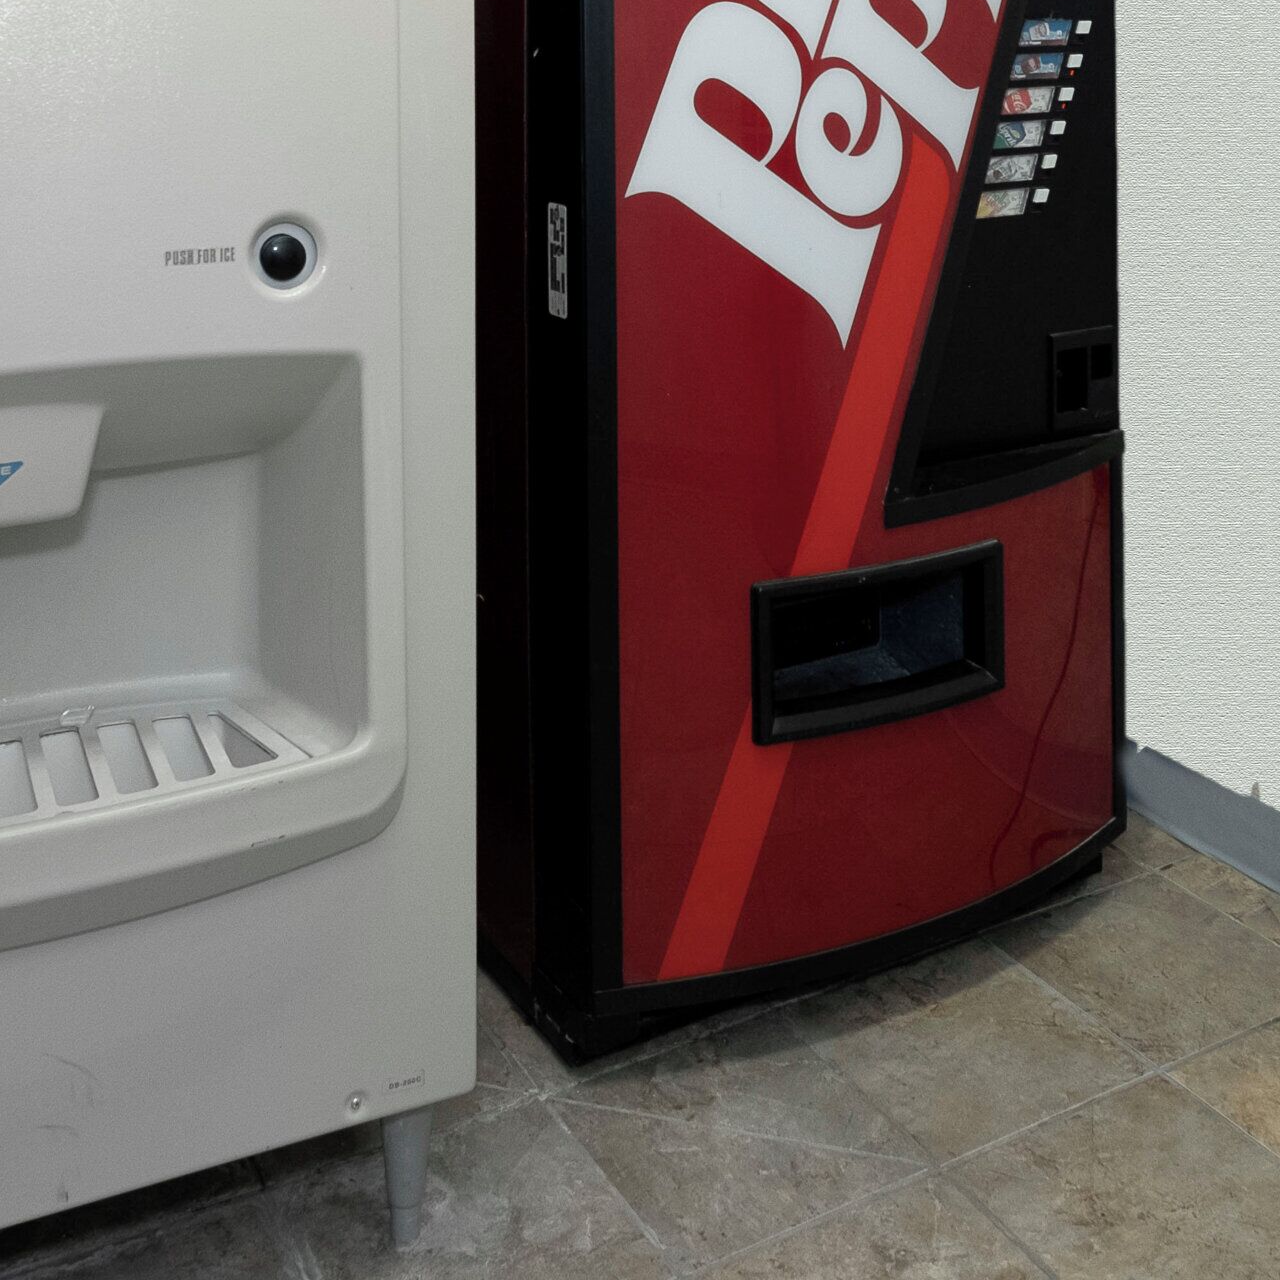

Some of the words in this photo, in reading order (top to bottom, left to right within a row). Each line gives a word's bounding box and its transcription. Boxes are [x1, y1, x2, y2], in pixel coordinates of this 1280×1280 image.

[165, 249, 194, 266] PUSH
[197, 248, 216, 265] FOR
[219, 247, 235, 263] ICE
